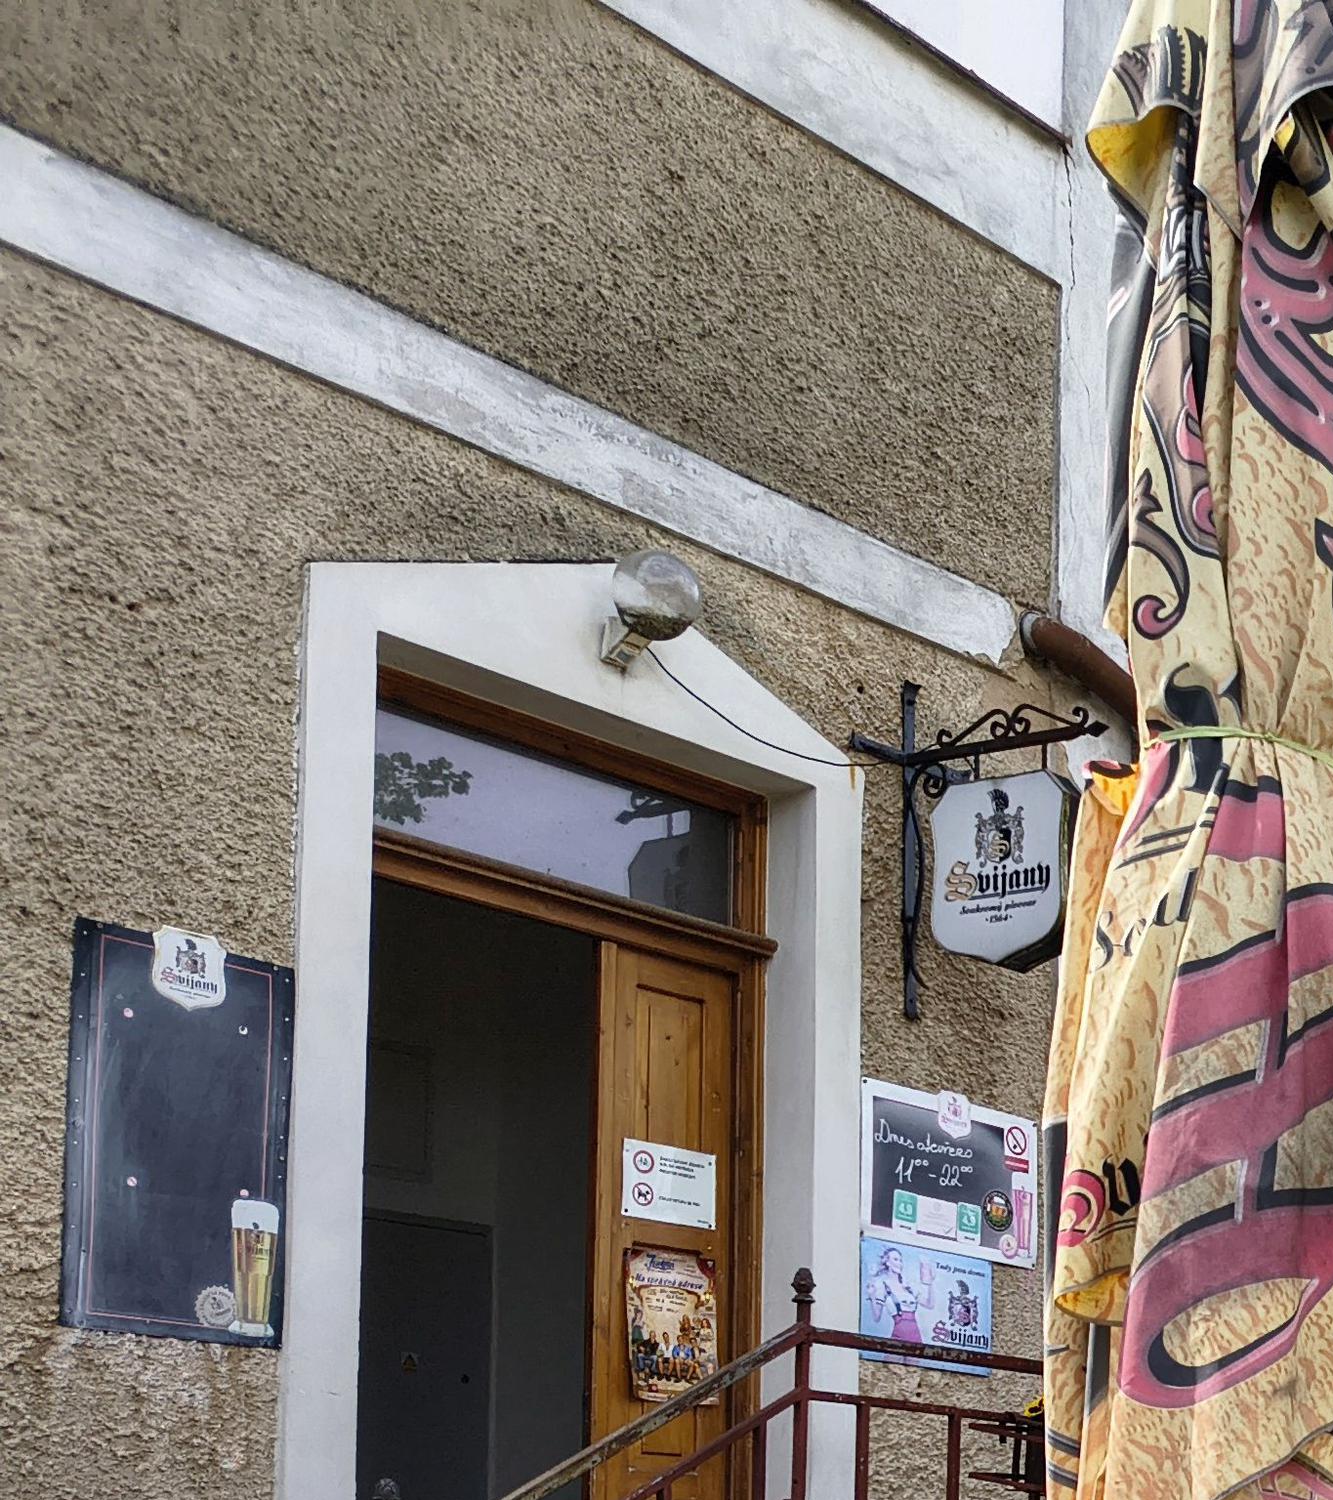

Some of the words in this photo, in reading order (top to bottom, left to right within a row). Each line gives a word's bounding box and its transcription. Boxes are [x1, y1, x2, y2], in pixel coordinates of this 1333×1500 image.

[945, 861, 1051, 902] Svijany
[160, 967, 218, 994] Svijany
[874, 1118, 915, 1149] Dnes
[936, 1262, 951, 1273] Tady
[932, 1320, 989, 1349] Svijany
